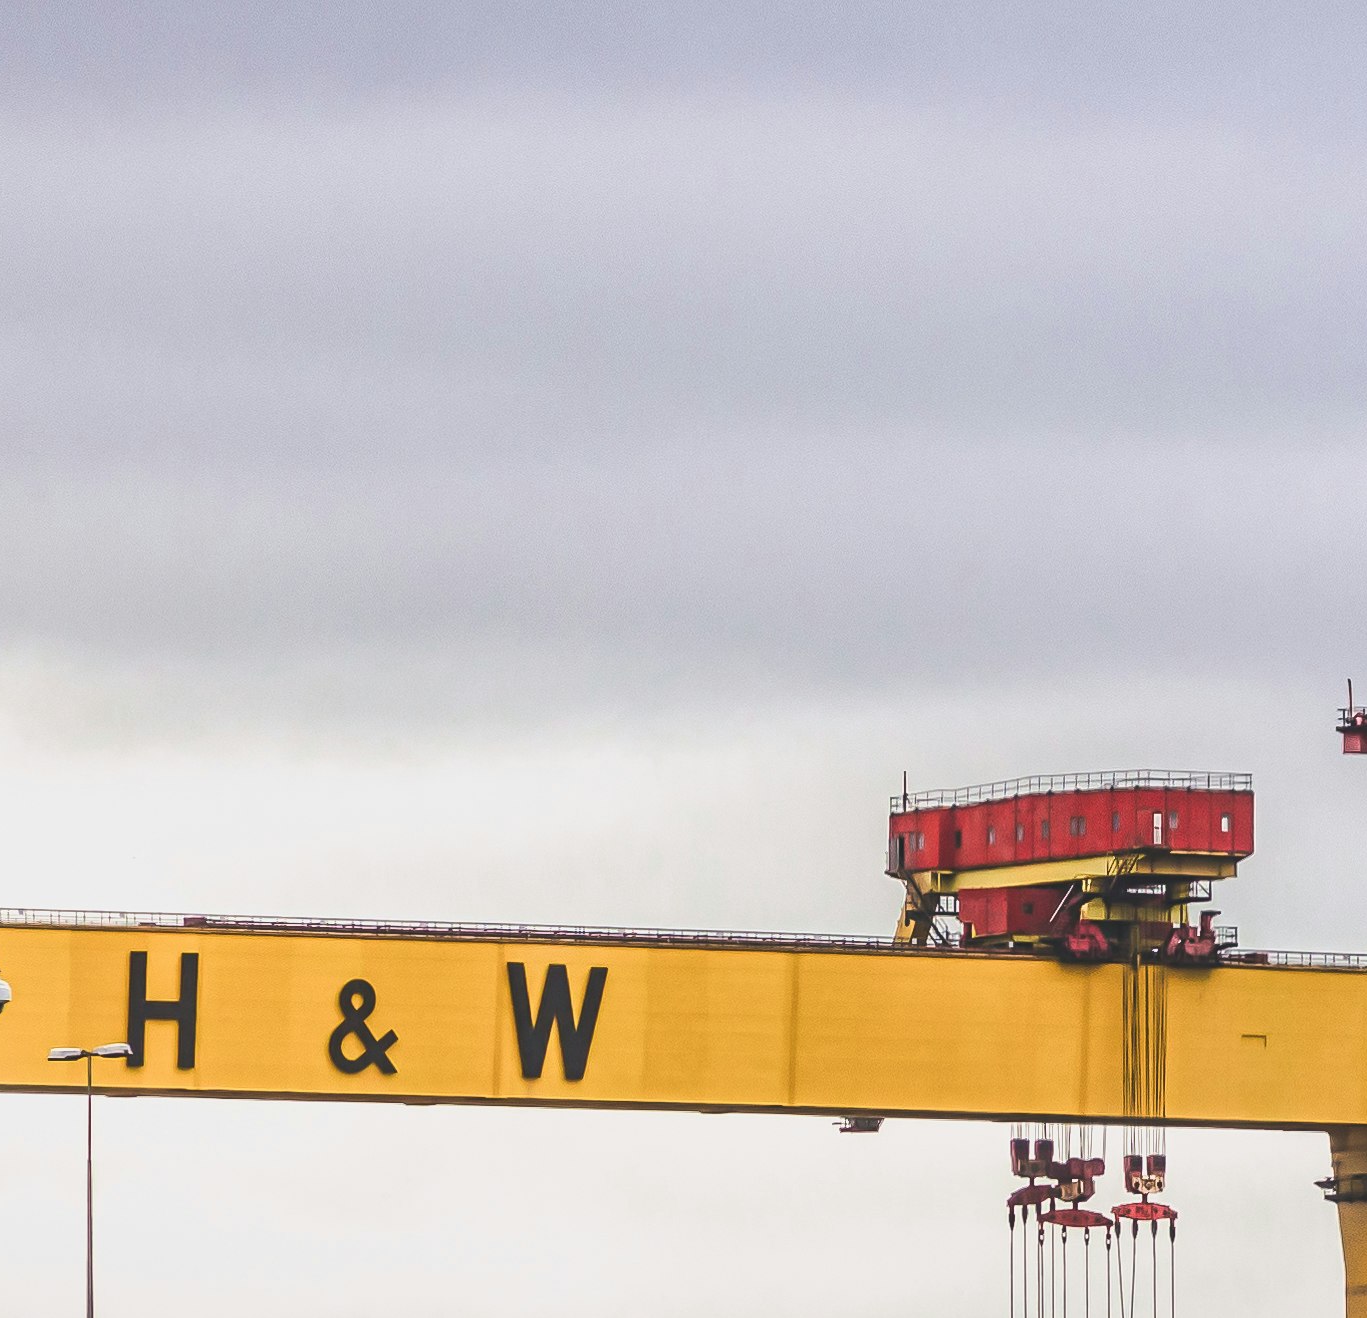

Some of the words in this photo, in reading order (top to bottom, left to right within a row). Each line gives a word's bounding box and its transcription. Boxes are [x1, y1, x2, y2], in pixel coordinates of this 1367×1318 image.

[126, 951, 199, 1069] H
[329, 979, 398, 1074] &
[507, 961, 608, 1080] W
